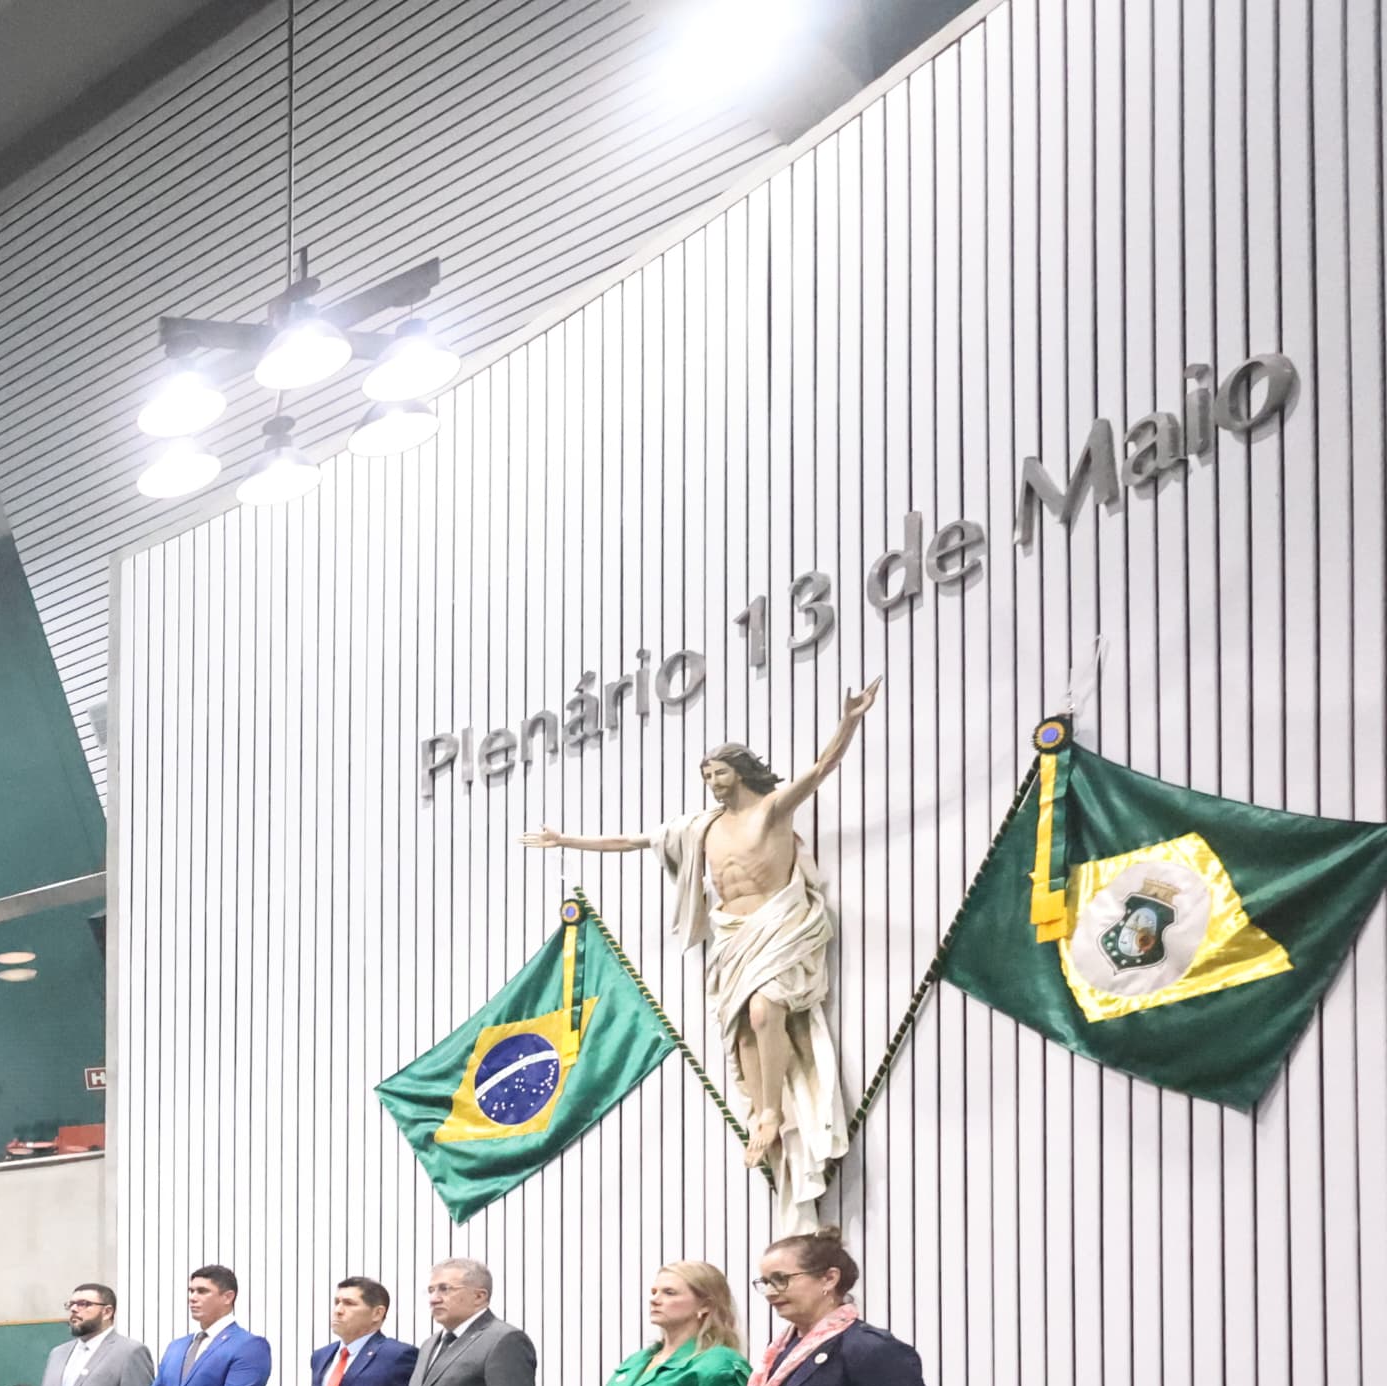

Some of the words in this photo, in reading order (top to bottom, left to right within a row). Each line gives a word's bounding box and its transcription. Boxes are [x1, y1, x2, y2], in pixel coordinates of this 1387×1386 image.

[421, 648, 707, 800] Plenário
[733, 569, 836, 668] 13
[866, 510, 986, 609] de
[1013, 352, 1302, 547] Maio
